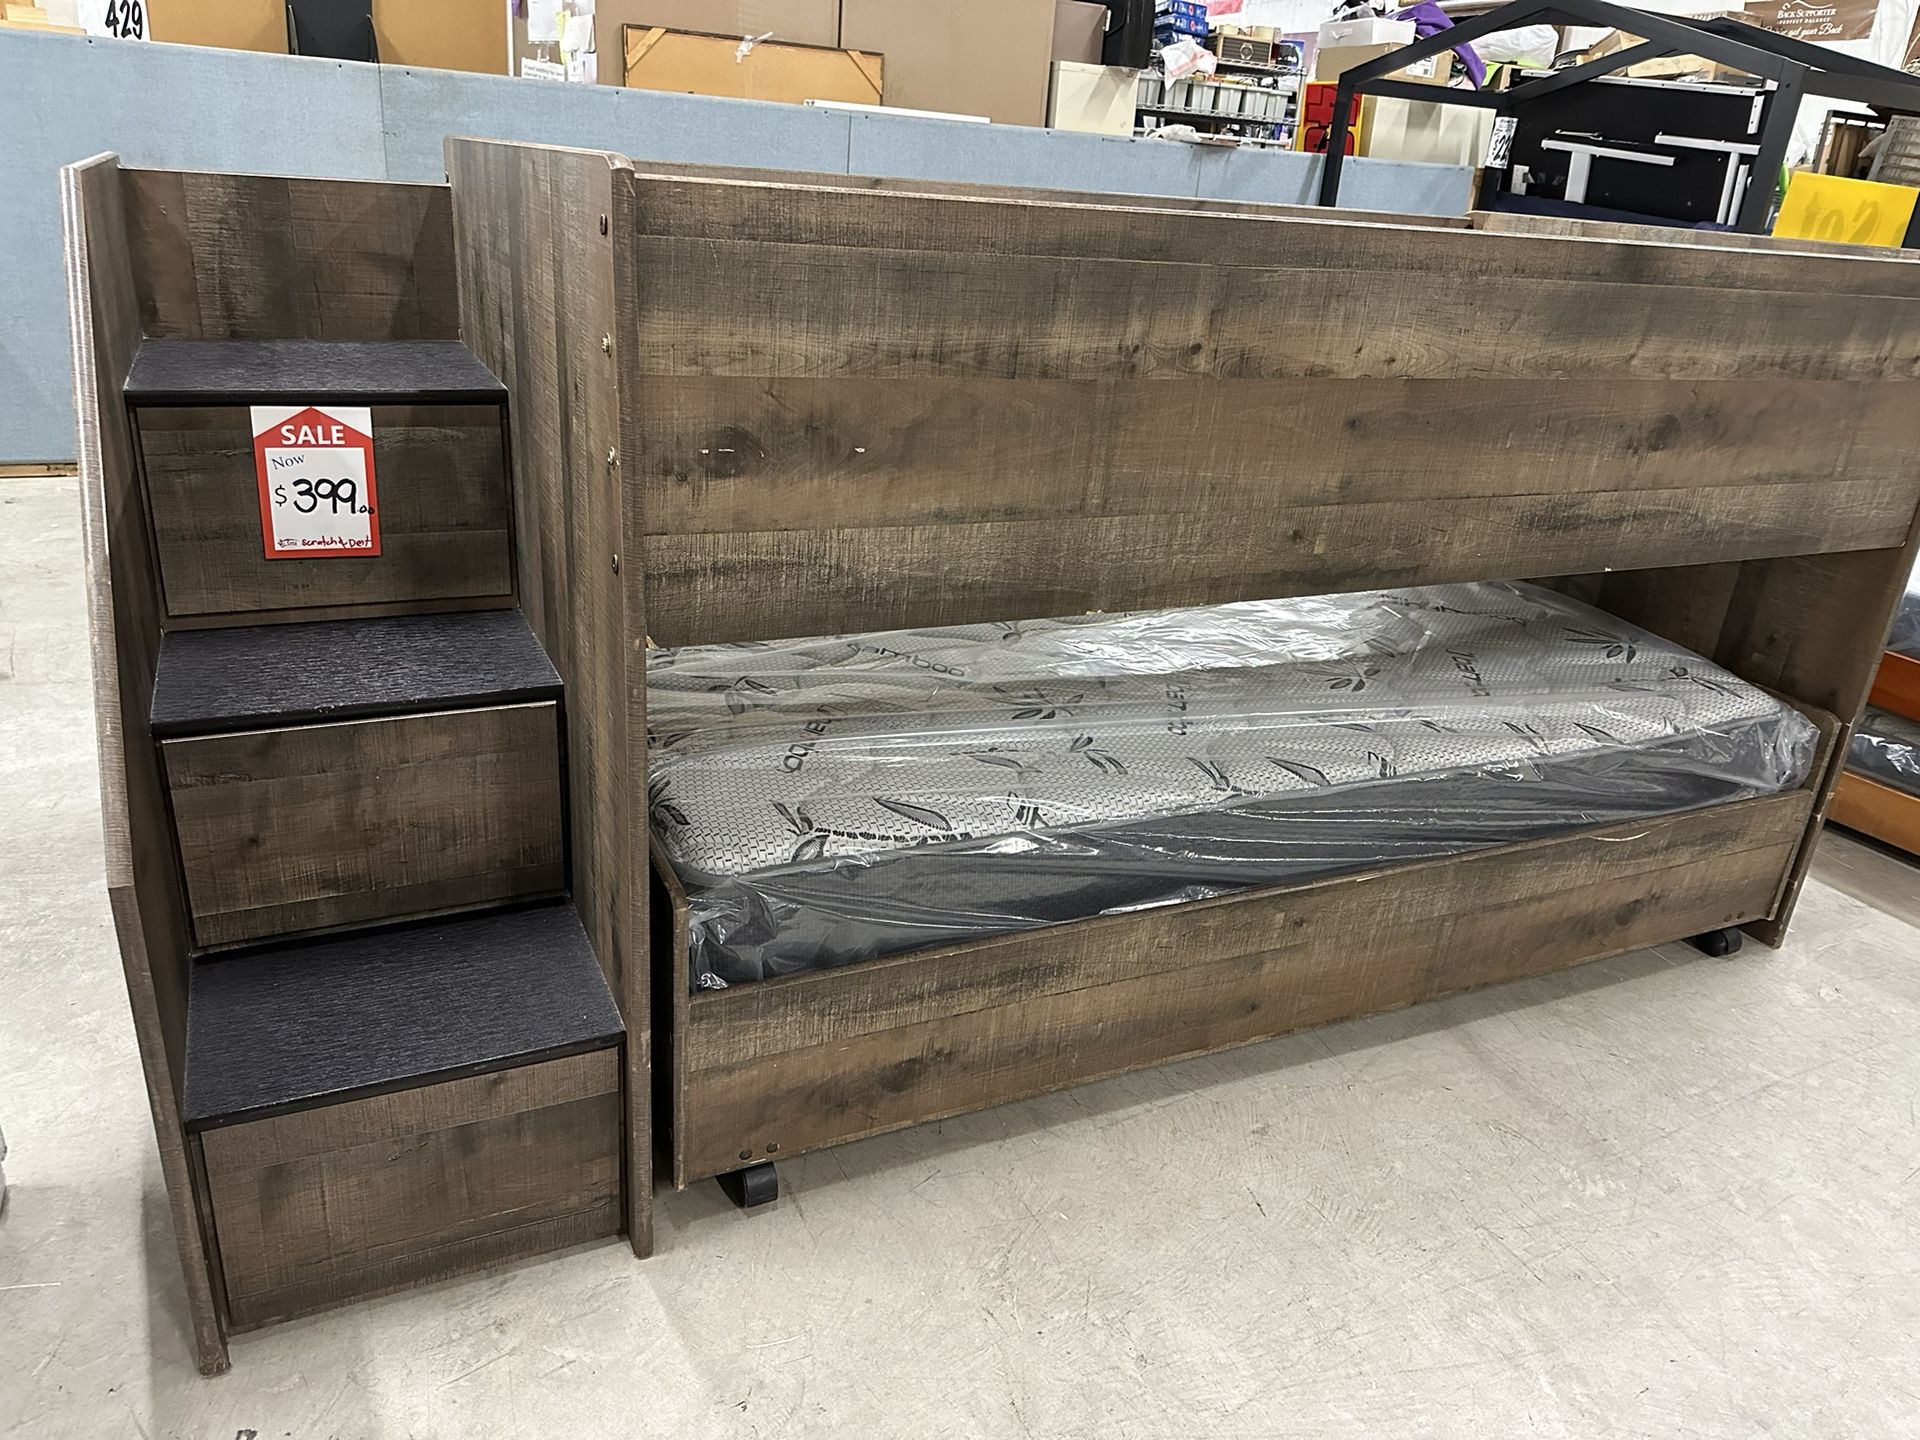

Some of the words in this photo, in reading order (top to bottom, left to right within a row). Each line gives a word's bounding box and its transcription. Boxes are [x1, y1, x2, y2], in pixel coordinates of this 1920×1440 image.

[105, 0, 142, 40] 429
[280, 424, 346, 446] SALE
[271, 454, 305, 470] Now
[348, 535, 373, 547] Dent
